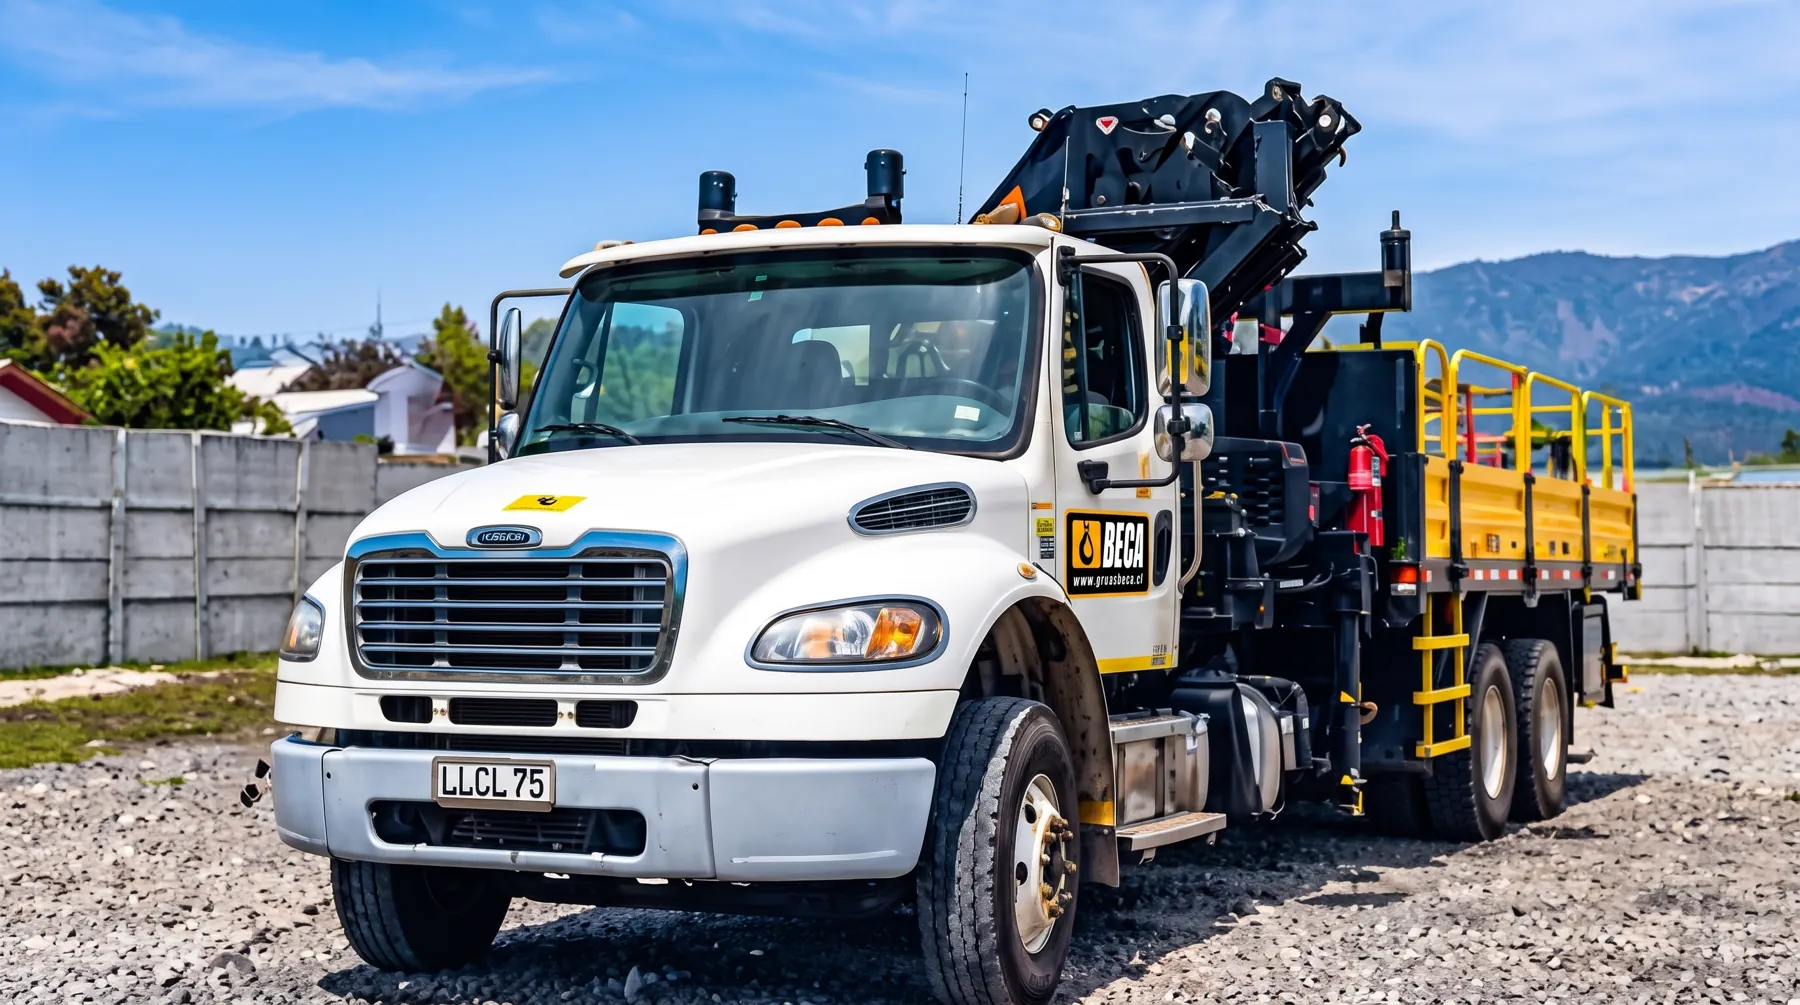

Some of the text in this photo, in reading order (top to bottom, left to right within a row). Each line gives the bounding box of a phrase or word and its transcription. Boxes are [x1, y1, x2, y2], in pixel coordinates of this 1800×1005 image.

[1102, 521, 1144, 569] BECA
[1073, 573, 1144, 588] www.gruasbeca.cl
[442, 766, 544, 798] LLCL 75
